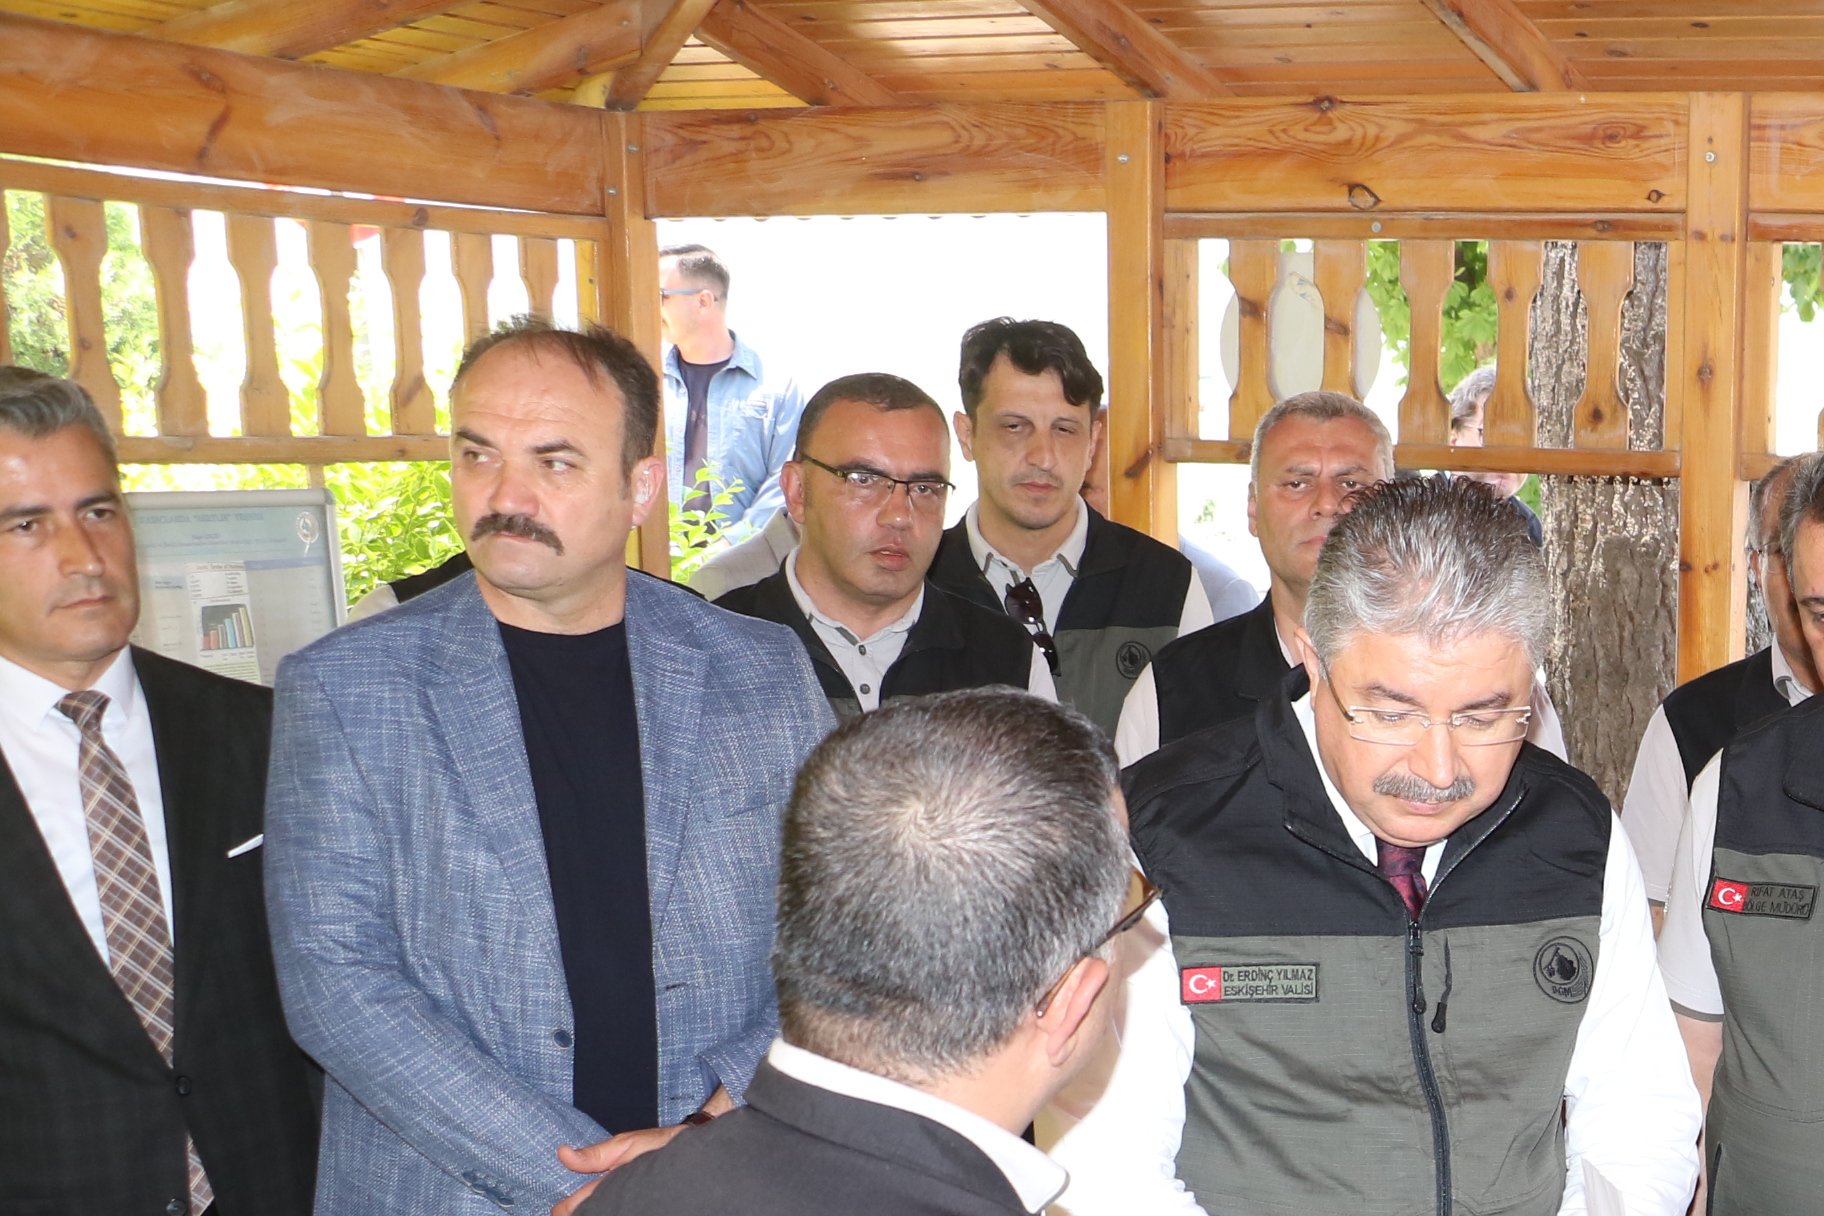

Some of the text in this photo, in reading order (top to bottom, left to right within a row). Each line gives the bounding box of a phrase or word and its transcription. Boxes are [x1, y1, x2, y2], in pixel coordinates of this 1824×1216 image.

[1777, 887, 1805, 901] ATAŞ
[1237, 967, 1273, 985] ERDİNÇ
[1274, 969, 1313, 981] YILMAZ
[1224, 982, 1313, 999] ESKİŞEHİR VALİSİ
